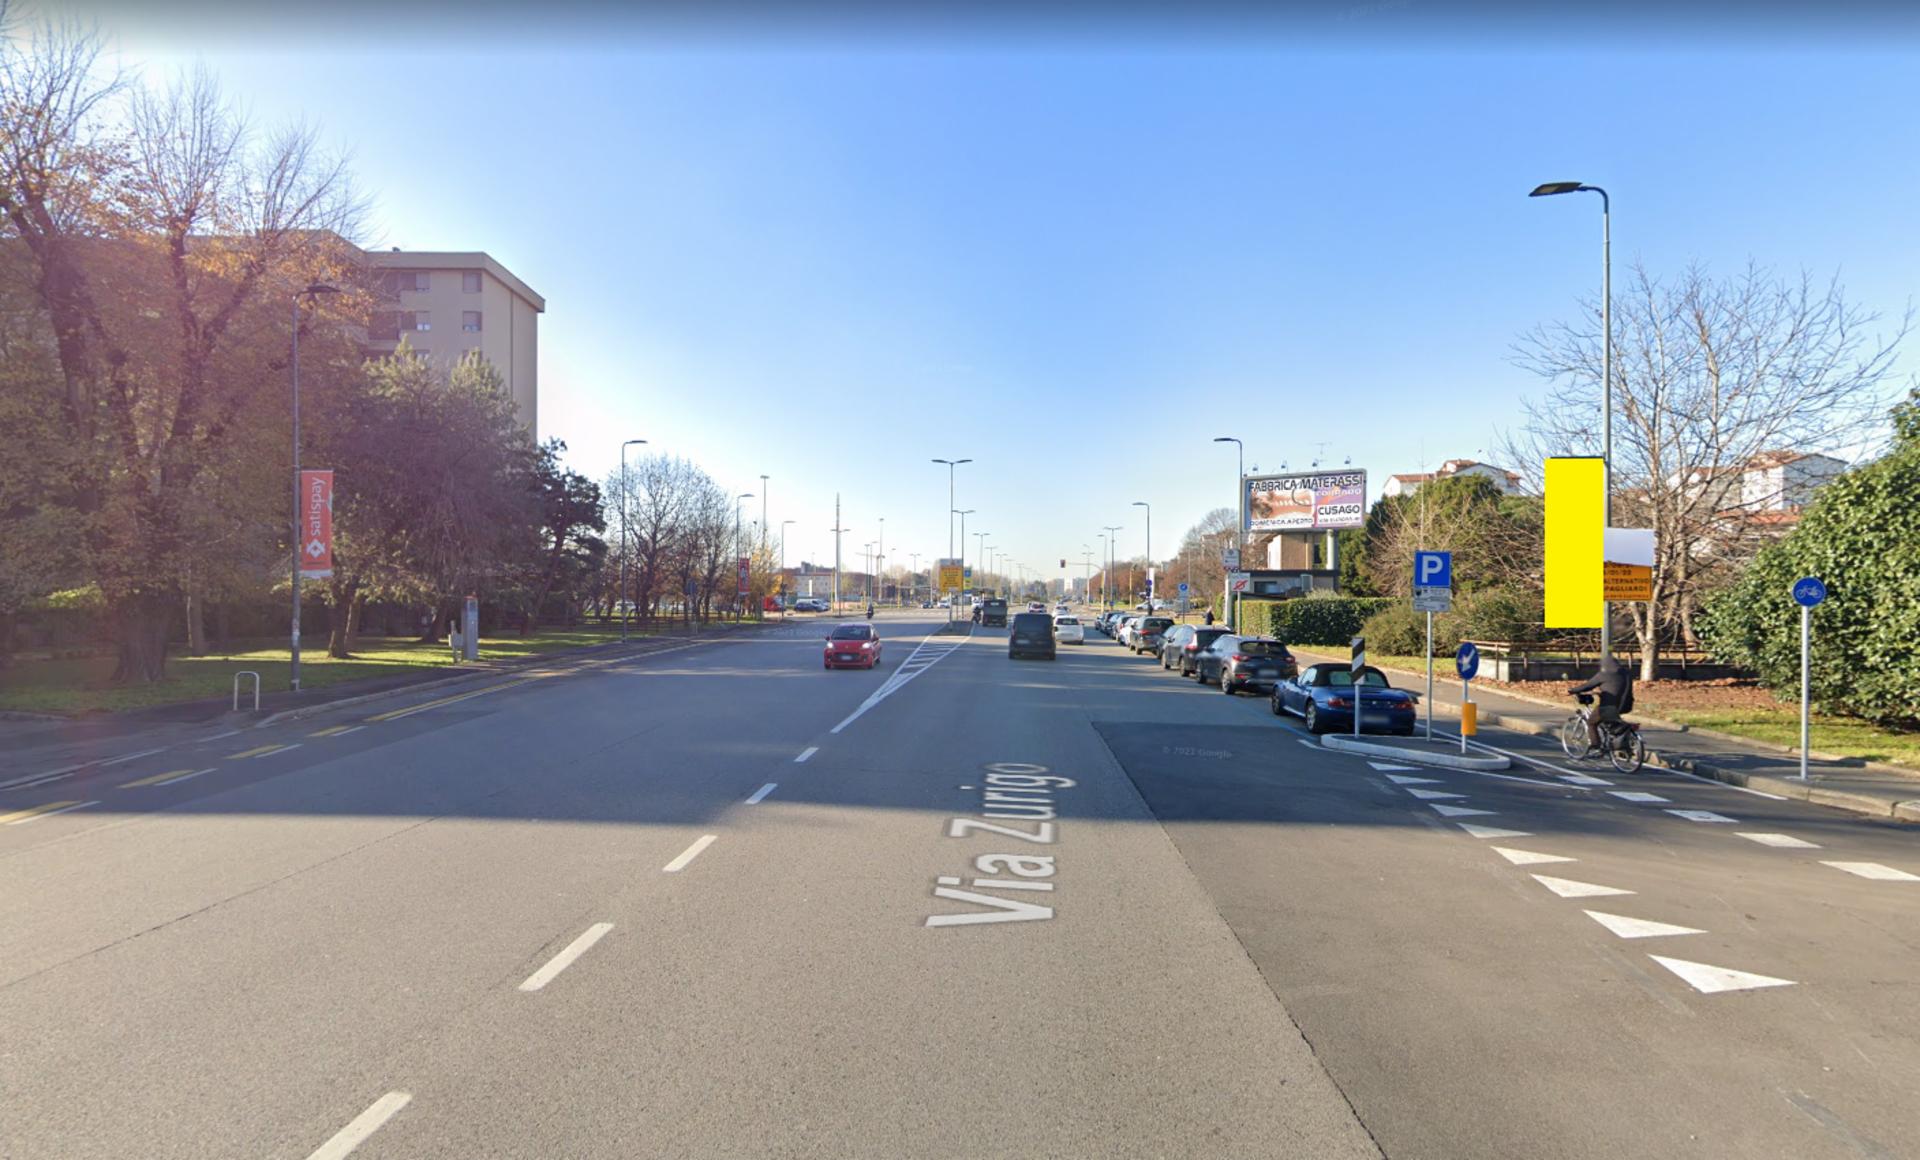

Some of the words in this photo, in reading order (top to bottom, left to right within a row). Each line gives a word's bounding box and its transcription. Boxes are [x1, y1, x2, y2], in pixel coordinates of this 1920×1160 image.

[1248, 479, 1297, 492] FABBRICA
[1299, 475, 1363, 489] MATERASSI
[308, 477, 326, 536] satispay
[1318, 505, 1360, 516] CUSAGO
[1421, 555, 1443, 583] P
